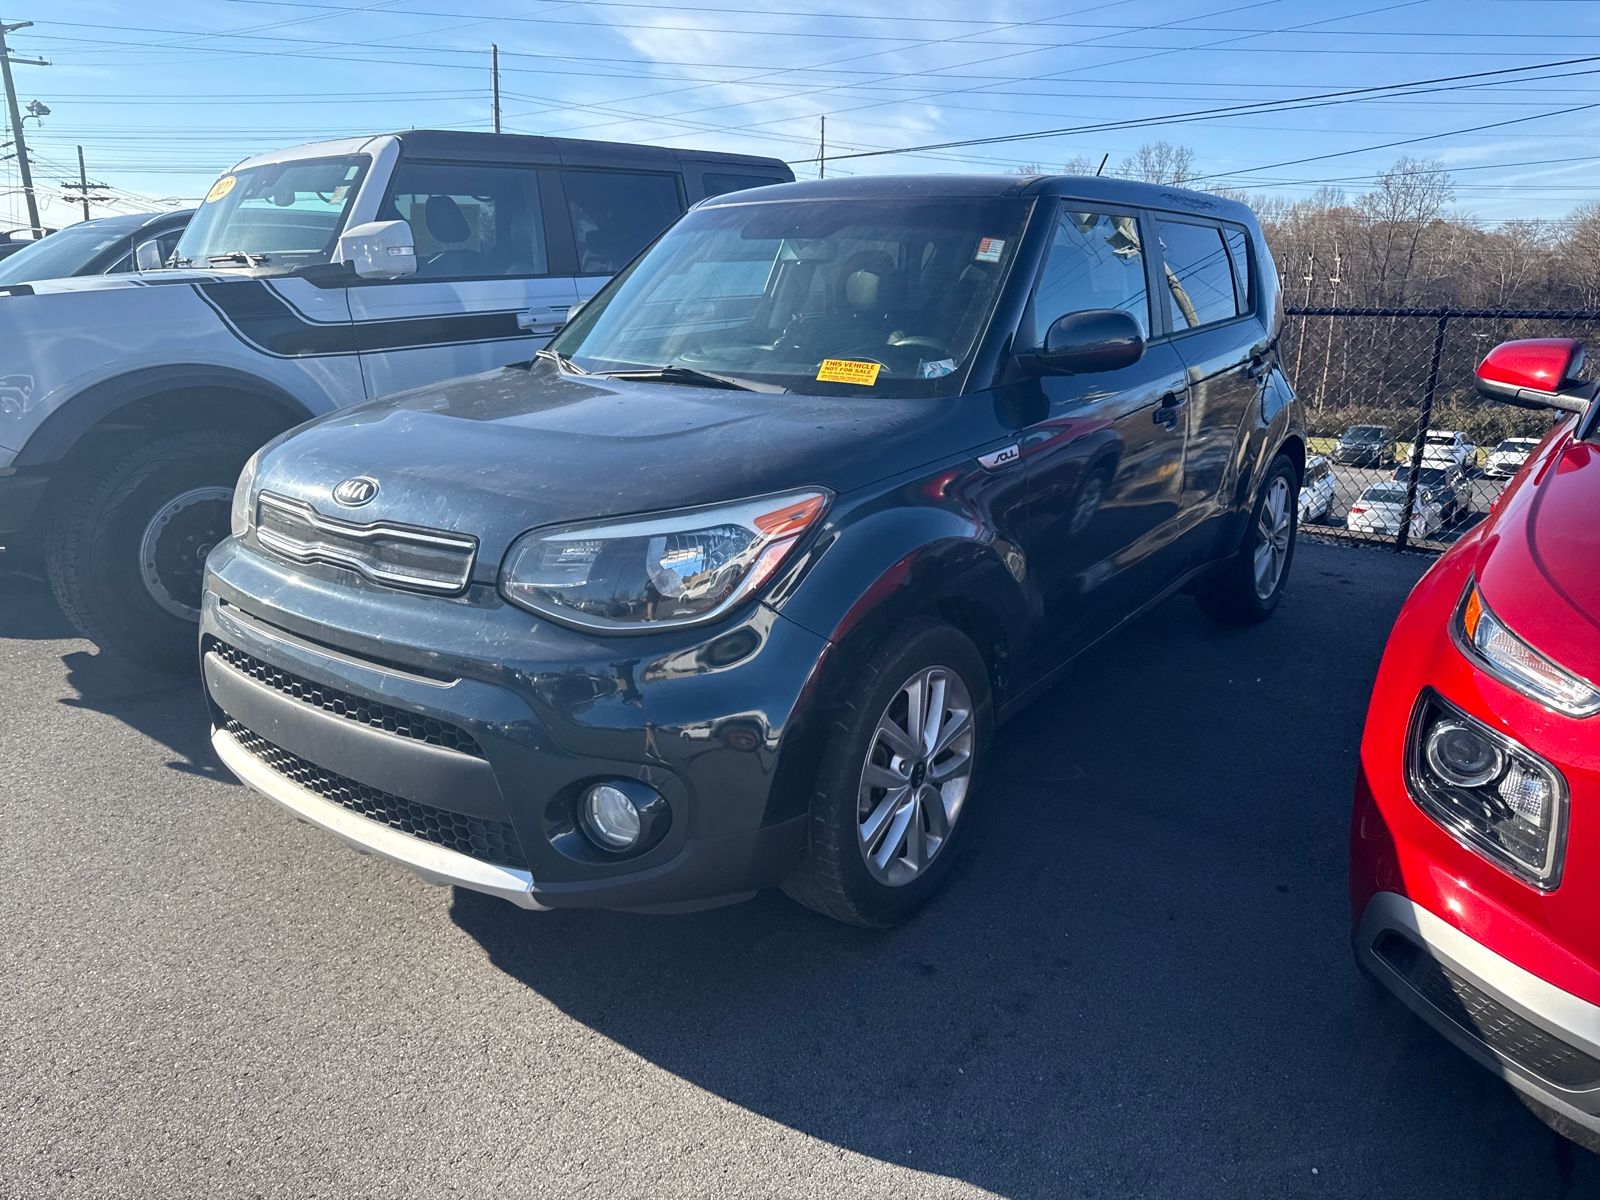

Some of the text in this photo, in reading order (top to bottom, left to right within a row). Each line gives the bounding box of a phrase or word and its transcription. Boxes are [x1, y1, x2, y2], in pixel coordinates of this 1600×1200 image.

[844, 361, 876, 370] VEHICLE
[993, 449, 1018, 465] SOUL
[338, 480, 369, 500] KIA
